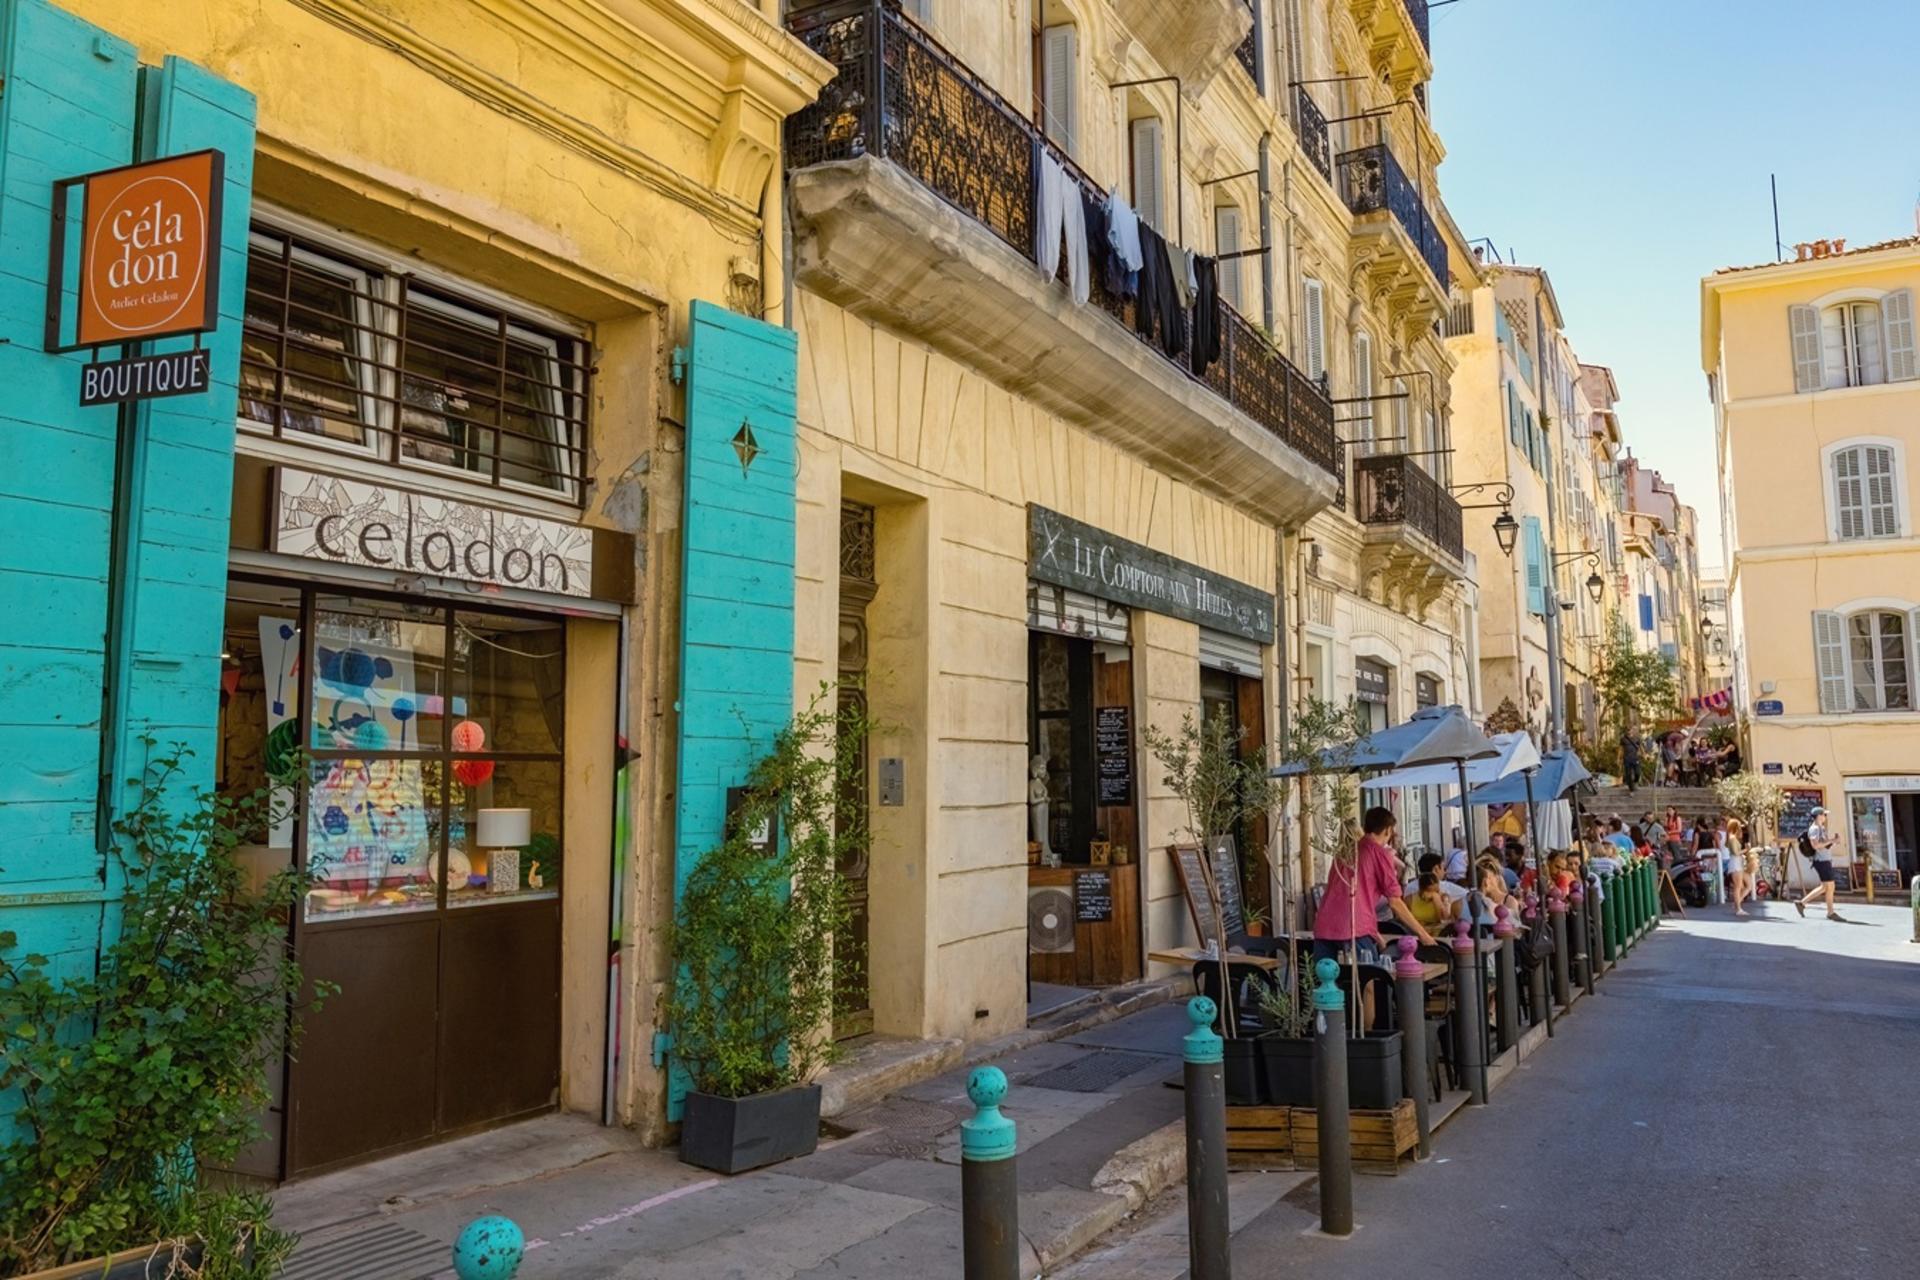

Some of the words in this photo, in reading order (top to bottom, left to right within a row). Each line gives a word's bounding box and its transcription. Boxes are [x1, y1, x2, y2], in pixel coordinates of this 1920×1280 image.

[112, 200, 183, 249] céla
[108, 243, 179, 288] don
[110, 296, 138, 309] Atelier
[85, 355, 203, 400] BOUTIQUE
[314, 494, 568, 591] celadon
